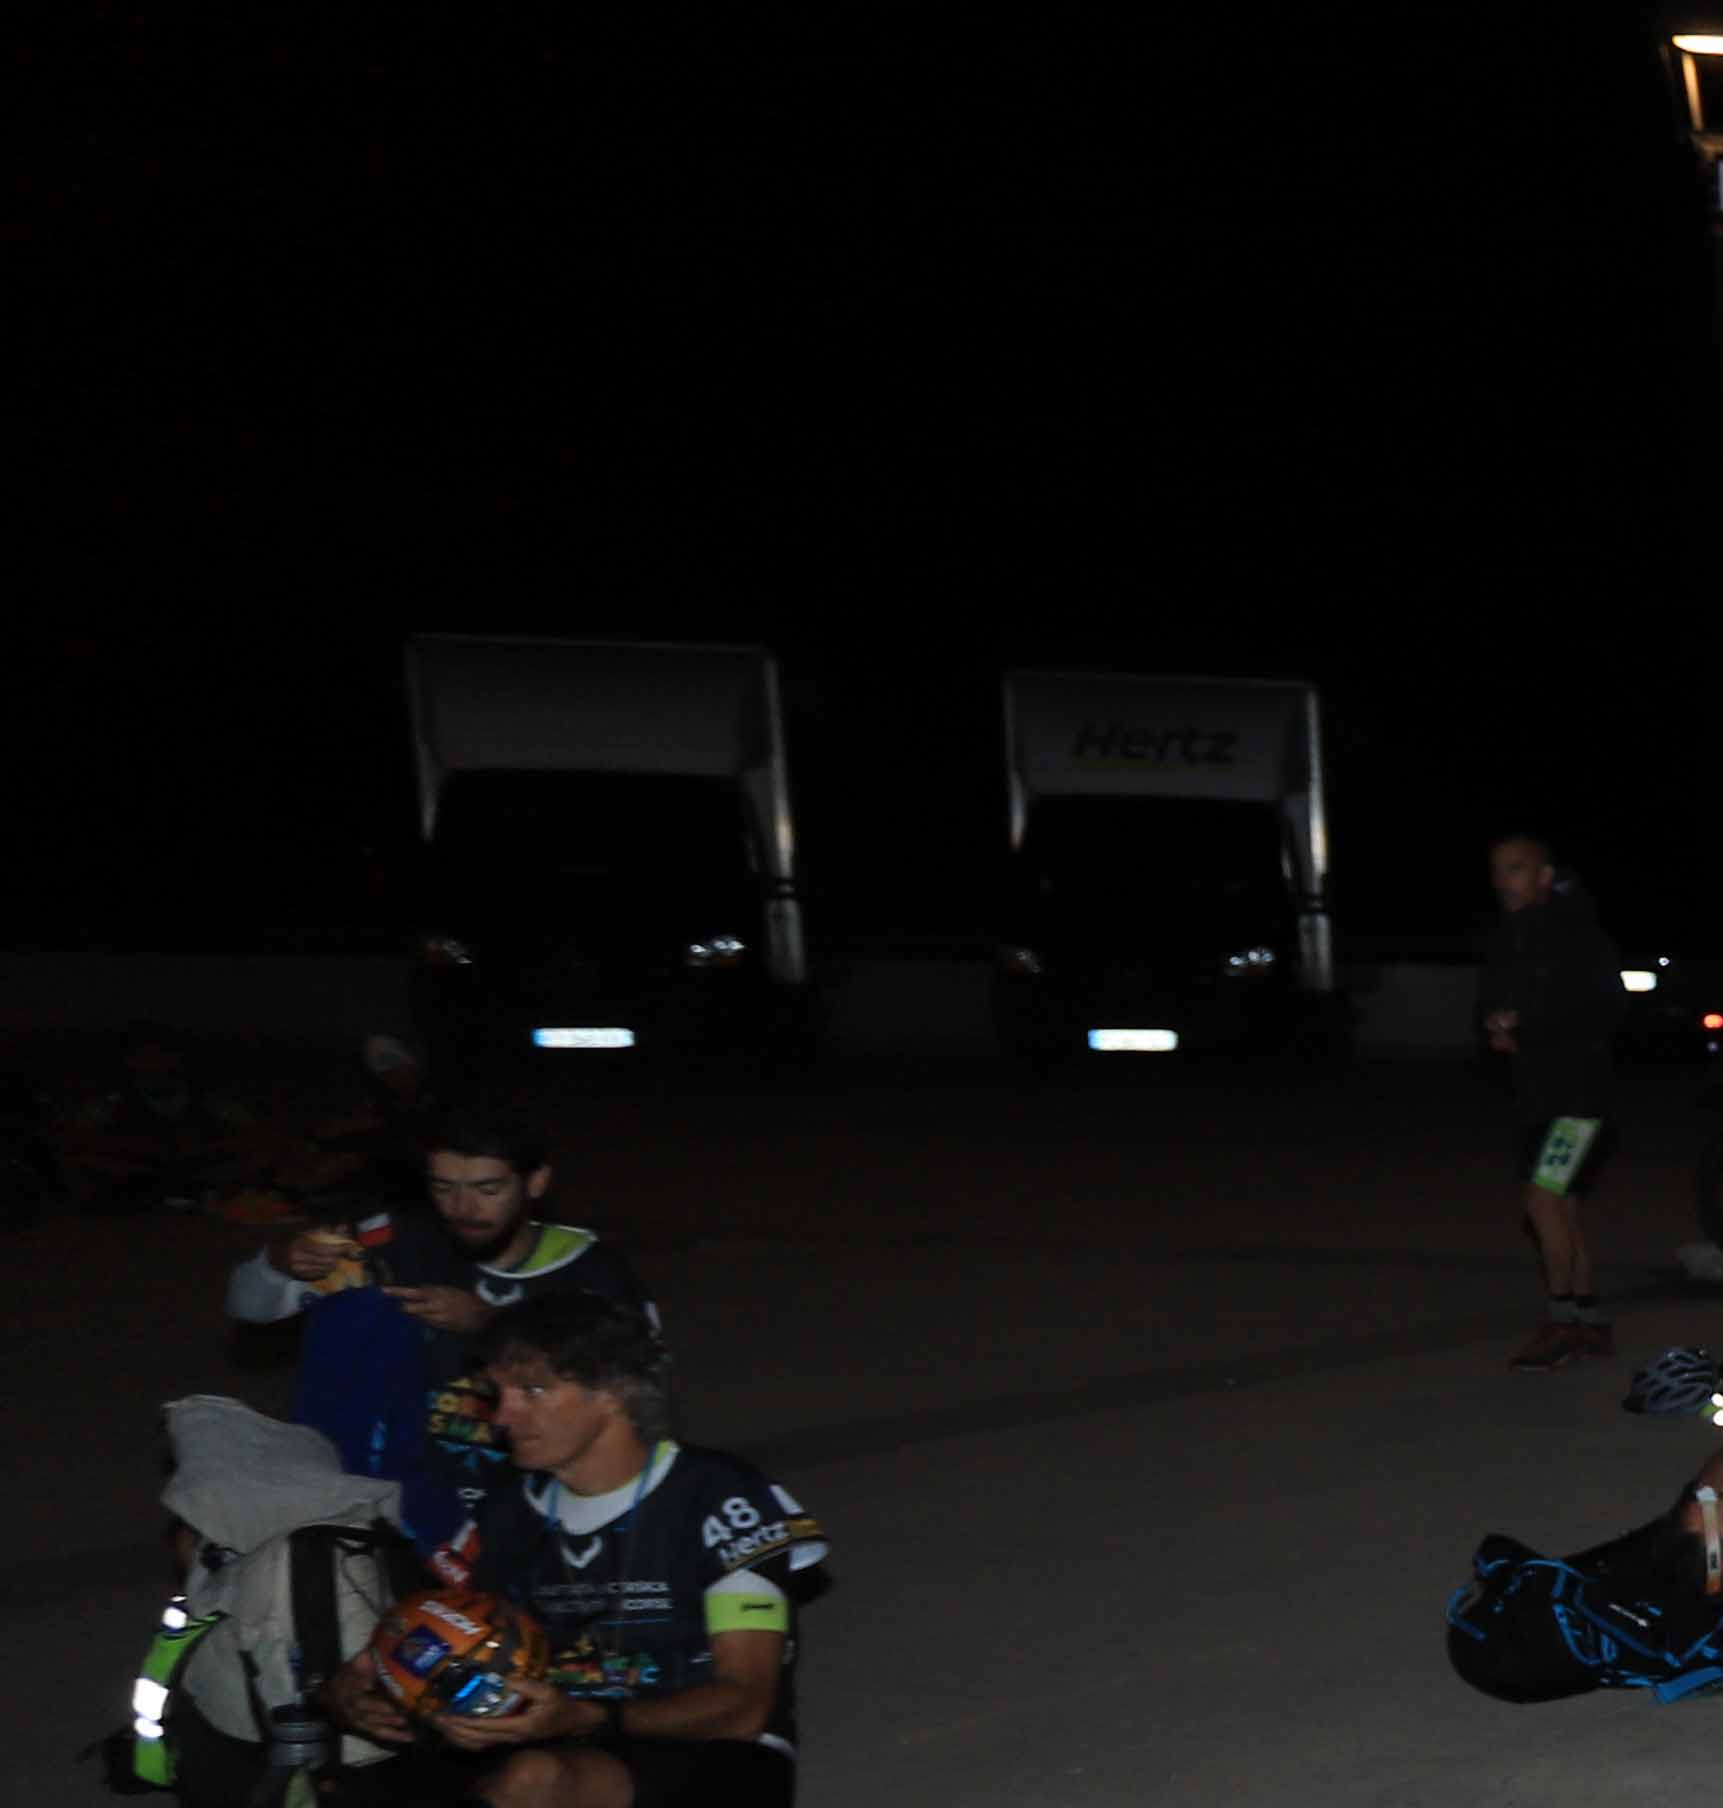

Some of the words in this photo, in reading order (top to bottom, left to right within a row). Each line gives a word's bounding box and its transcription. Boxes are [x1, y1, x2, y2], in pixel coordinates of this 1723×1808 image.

[1073, 722, 1238, 767] Hertz
[702, 1496, 762, 1549] 48
[718, 1521, 790, 1565] Hertz
